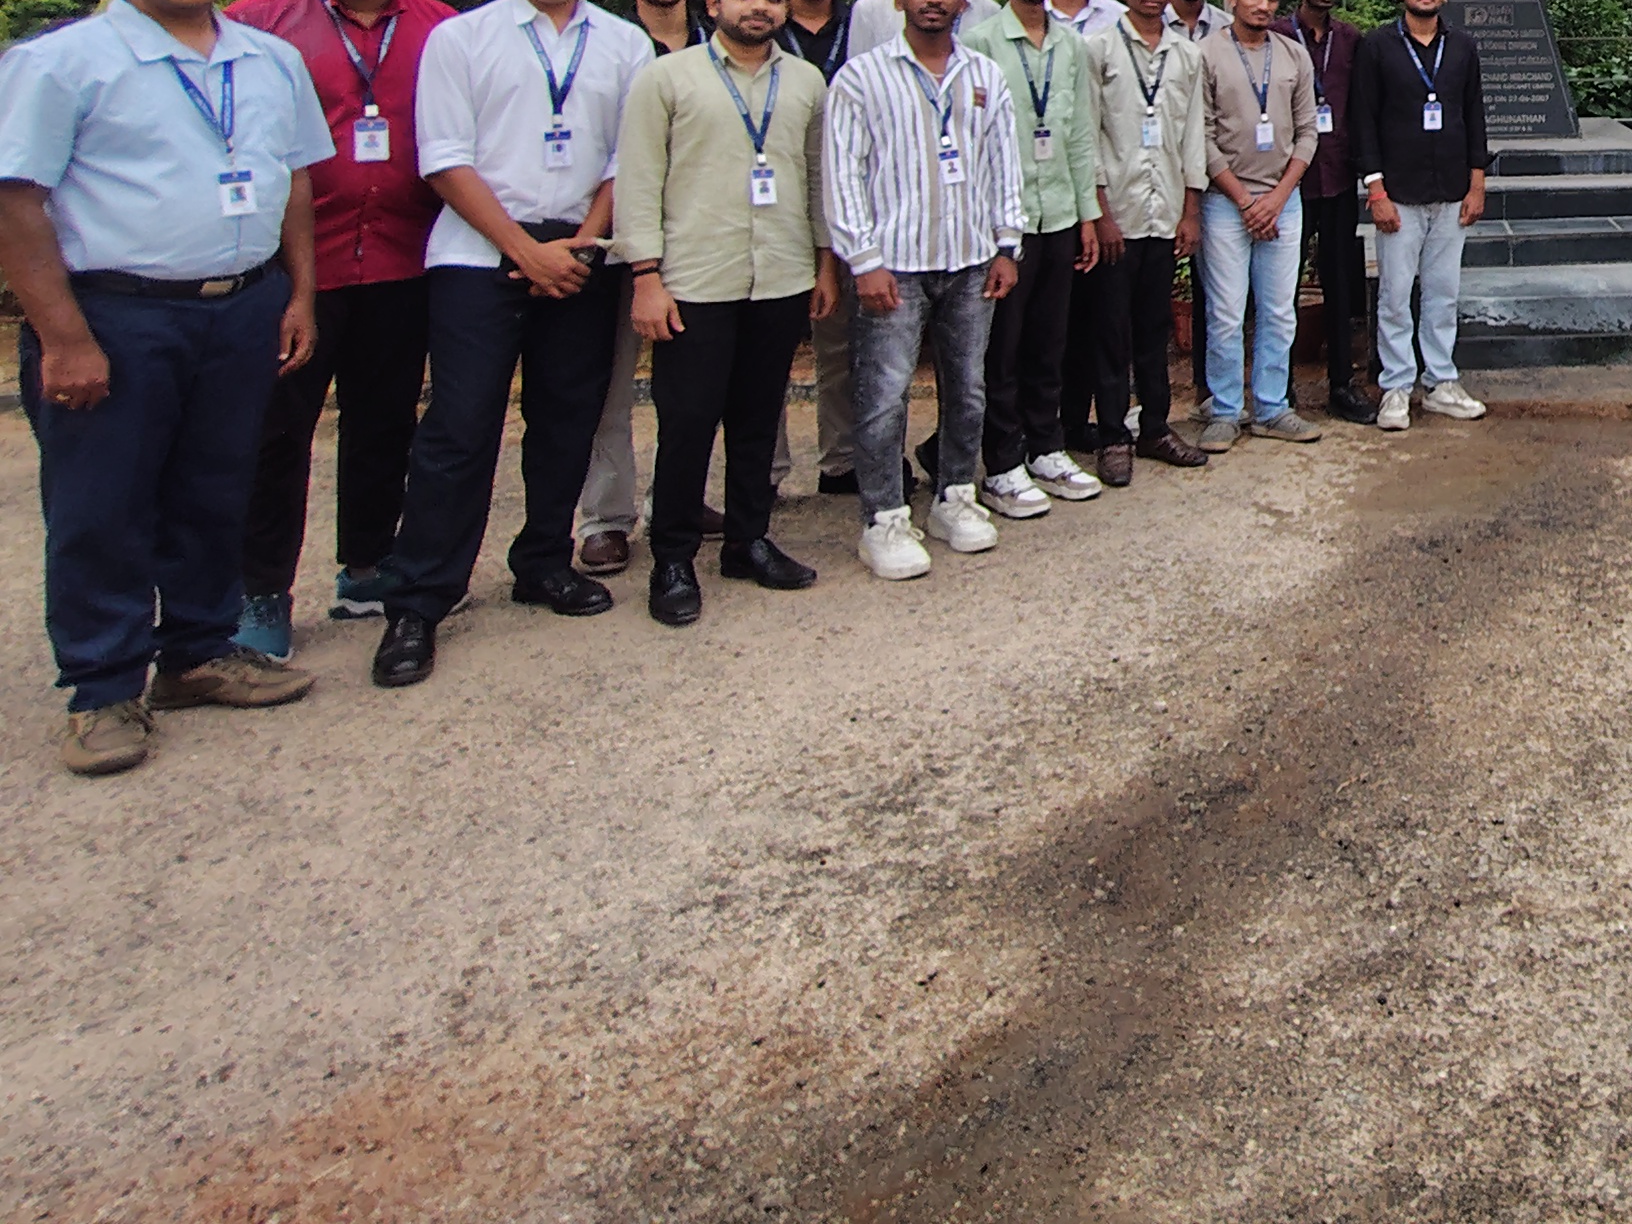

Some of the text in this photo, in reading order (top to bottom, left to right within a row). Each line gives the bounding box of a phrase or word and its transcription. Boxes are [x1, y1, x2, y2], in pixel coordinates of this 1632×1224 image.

[1488, 15, 1509, 25] HAL
[1481, 72, 1509, 82] CHAND
[1484, 113, 1546, 124] AGHUNATHAN
